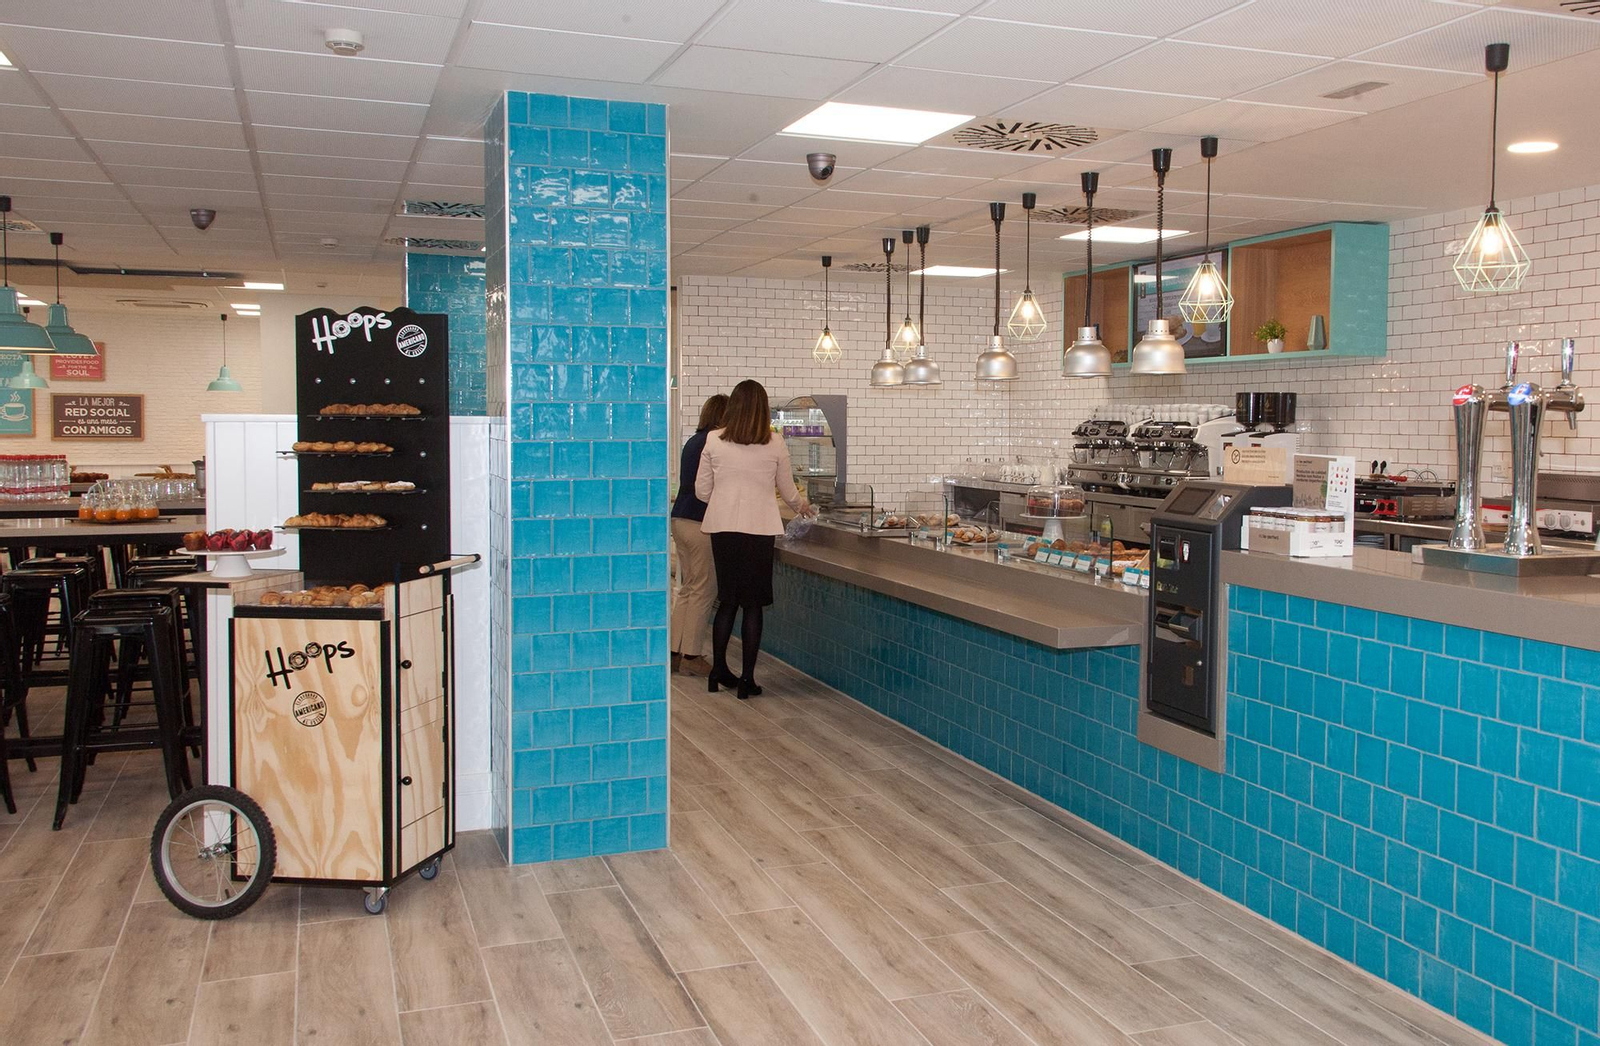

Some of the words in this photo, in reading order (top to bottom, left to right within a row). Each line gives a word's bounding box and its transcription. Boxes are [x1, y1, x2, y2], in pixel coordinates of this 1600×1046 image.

[311, 312, 392, 355] Hoops
[79, 397, 90, 406] LA
[92, 397, 115, 406] MEJOR
[65, 408, 88, 417] RED
[90, 408, 130, 417] SOCIAL
[63, 426, 87, 434] CON
[89, 426, 132, 435] AMIGOS
[265, 641, 356, 690] Hoops
[295, 701, 325, 717] AMERICANO
